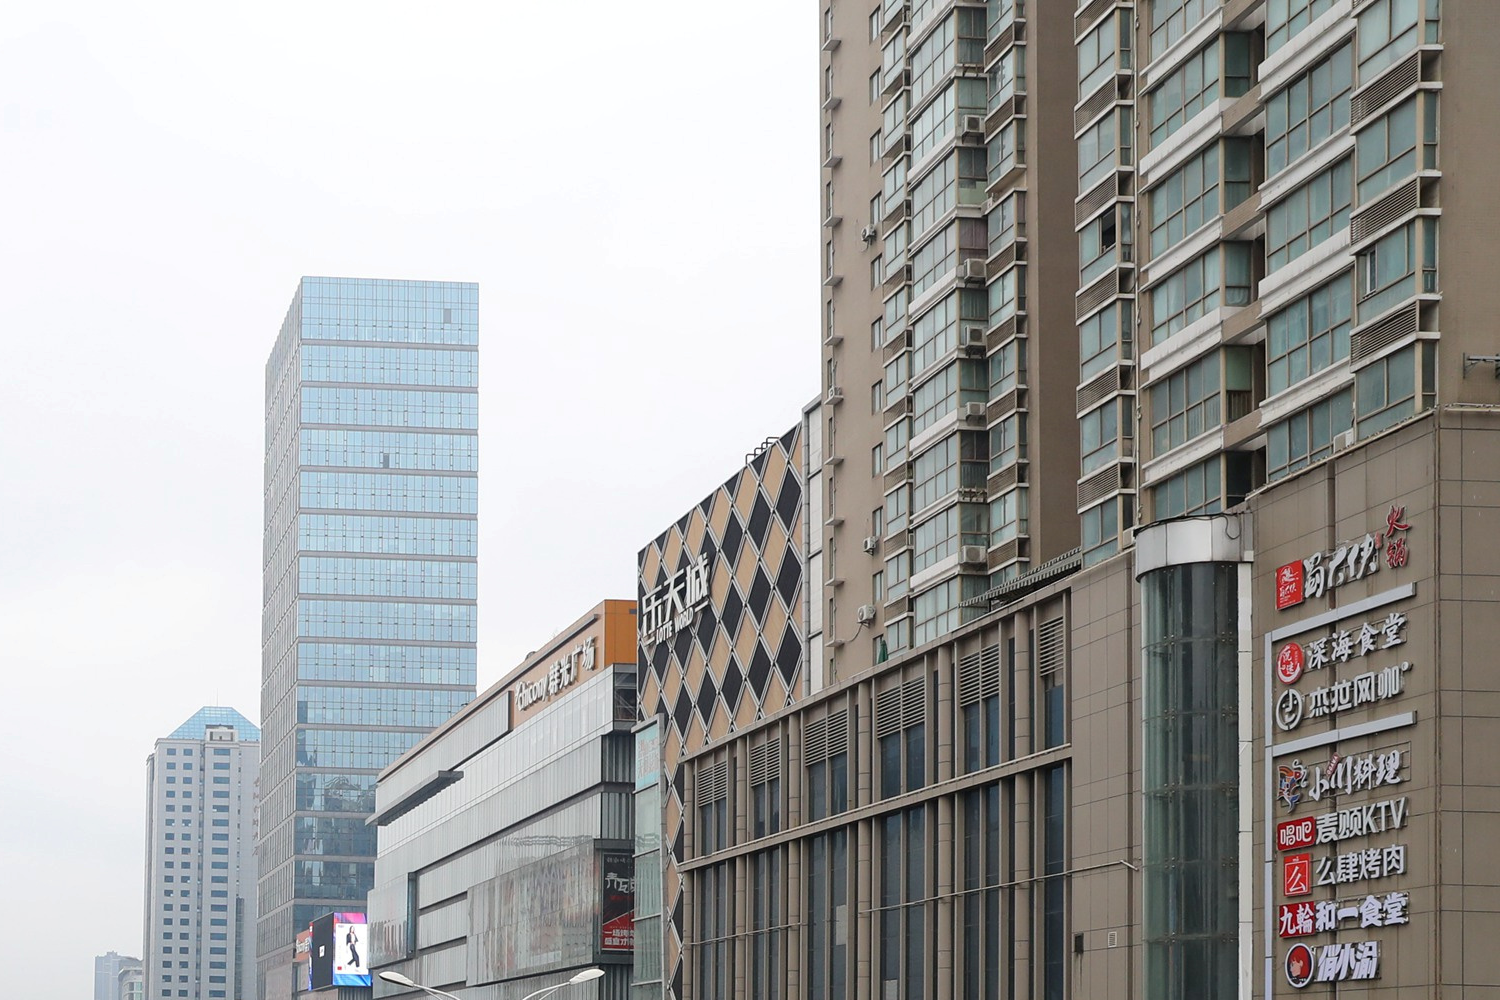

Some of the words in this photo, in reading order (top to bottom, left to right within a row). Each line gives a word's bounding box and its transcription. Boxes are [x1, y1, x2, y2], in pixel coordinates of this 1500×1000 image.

[1385, 504, 1412, 569] 火锅
[1303, 533, 1377, 598] 蜀大侠
[642, 552, 709, 638] 乐天城
[655, 620, 672, 645] LOTTE
[674, 606, 694, 634] WORLD
[1307, 612, 1406, 670] 深海食堂
[549, 635, 597, 697] 群光广场
[1308, 664, 1401, 719] 杰拉网咖
[1308, 749, 1402, 801] 小川料理
[1279, 821, 1312, 846] 唱吧
[1315, 844, 1405, 886] 么肆烤肉
[1279, 903, 1314, 935] 九輪
[1315, 891, 1409, 932] 和一食堂
